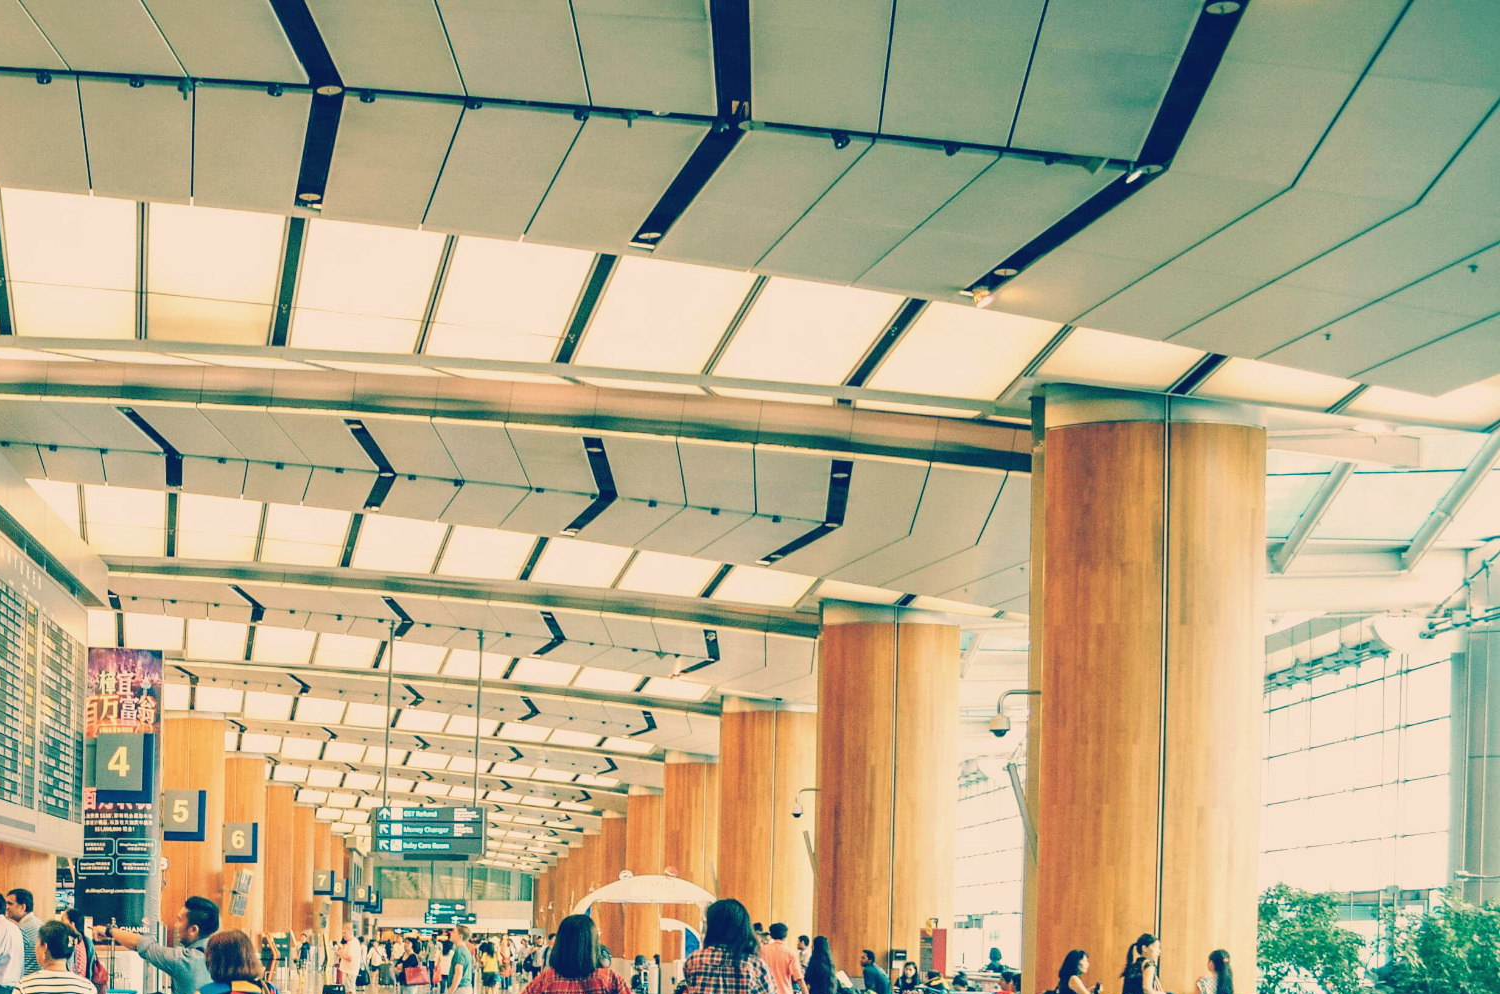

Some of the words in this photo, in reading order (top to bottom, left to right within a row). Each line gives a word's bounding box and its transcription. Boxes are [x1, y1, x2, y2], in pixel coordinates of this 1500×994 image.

[107, 746, 130, 777] 4
[172, 800, 189, 823] 5
[231, 830, 245, 849] 6
[317, 875, 327, 887] 7
[334, 882, 342, 893] 8
[358, 888, 365, 898] 9
